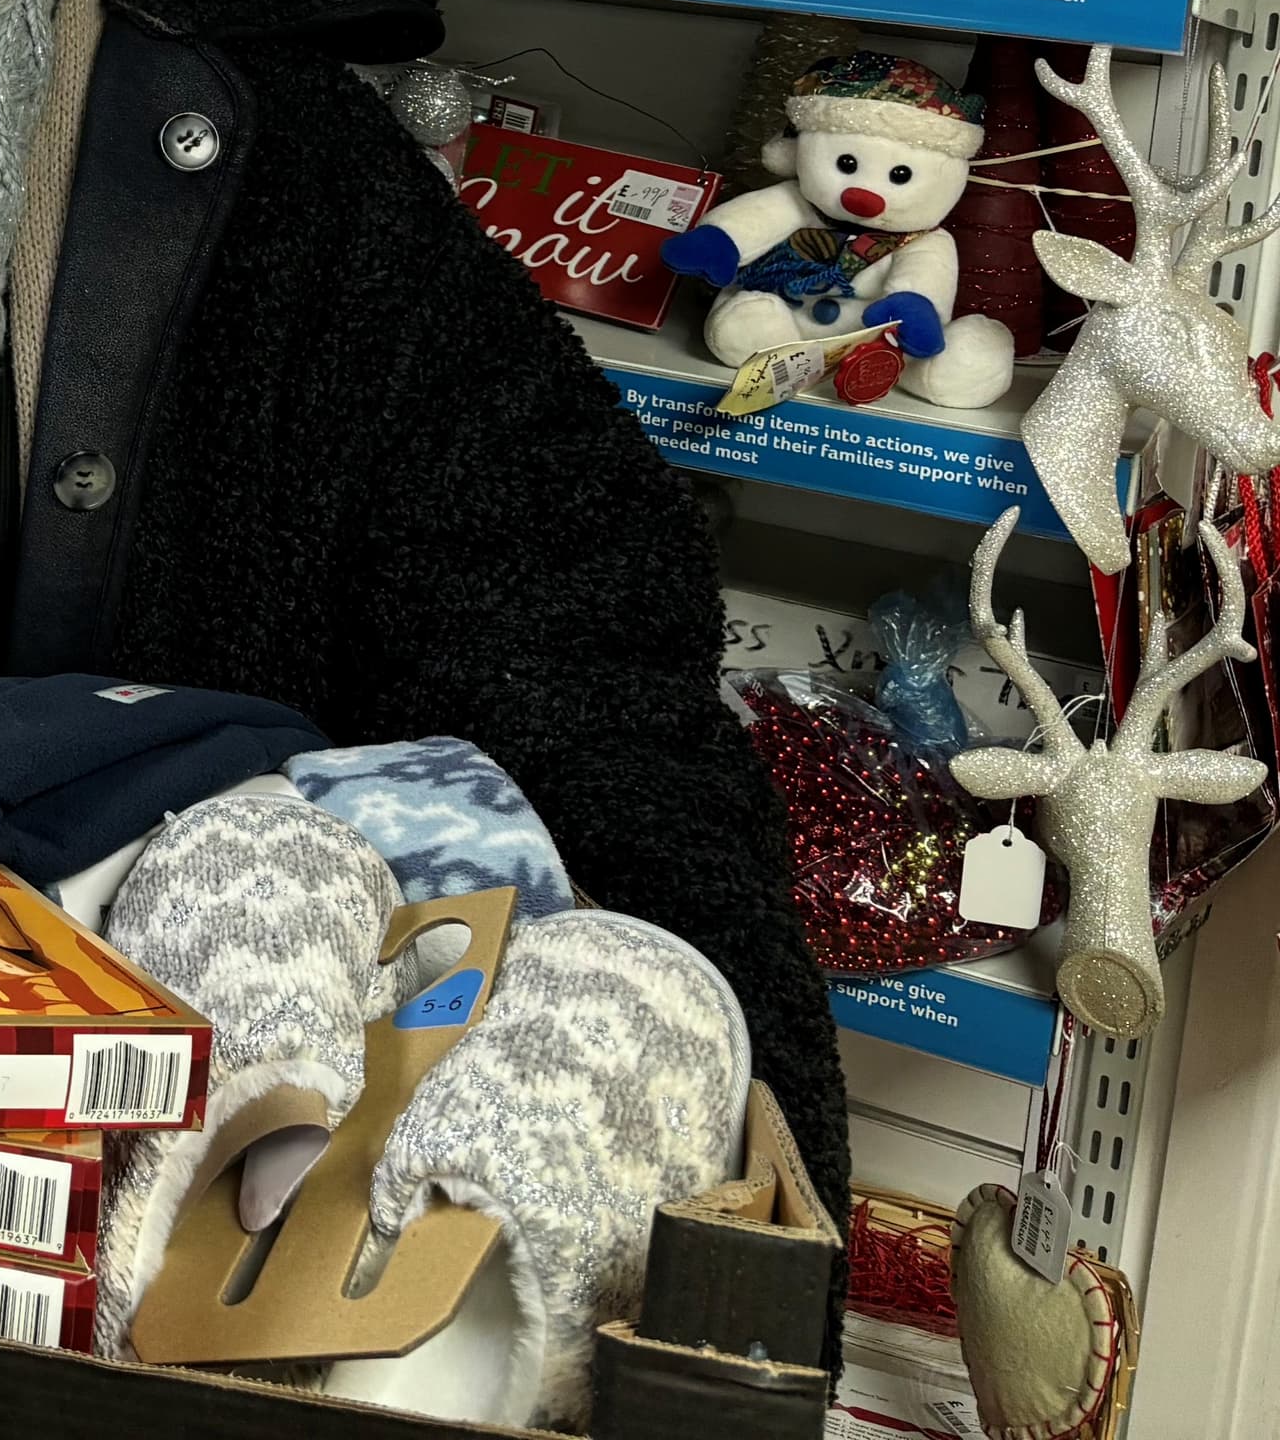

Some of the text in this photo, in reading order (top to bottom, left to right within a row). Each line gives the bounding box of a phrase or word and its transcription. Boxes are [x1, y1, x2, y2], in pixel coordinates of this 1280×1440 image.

[627, 389, 647, 407] By
[770, 415, 819, 436] items
[824, 425, 861, 444] into
[866, 436, 939, 460] actions,
[944, 449, 969, 464] we
[975, 454, 1014, 472] give
[631, 406, 1028, 495] lder people and their families support when
[649, 434, 759, 464] needed most
[421, 995, 463, 1013] 5-6
[880, 976, 946, 1004] we give
[837, 983, 959, 1027] support when
[90, 1109, 162, 1120] 72417 19637
[0, 1230, 38, 1246] 19637
